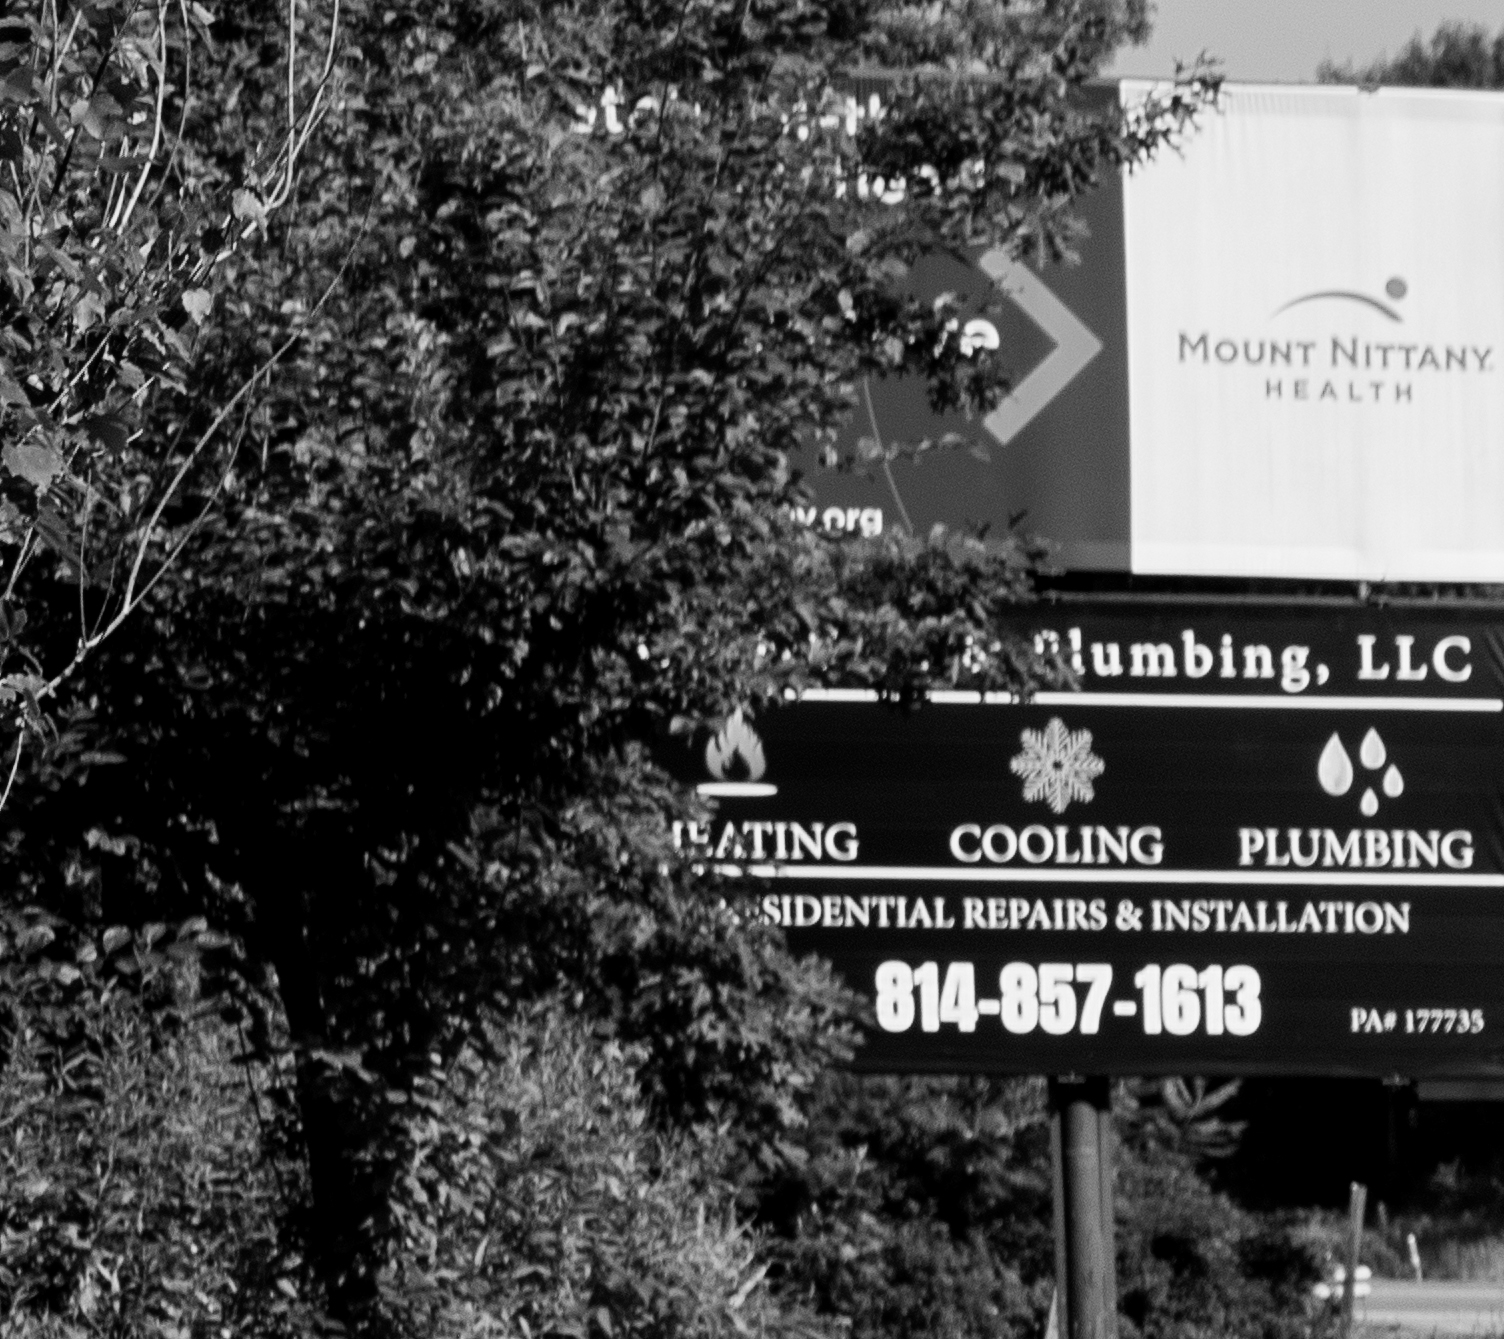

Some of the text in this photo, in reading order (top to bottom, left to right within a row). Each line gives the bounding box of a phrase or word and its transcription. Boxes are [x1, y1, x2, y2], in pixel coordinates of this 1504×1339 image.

[1265, 379, 1412, 401] HEALTH
[1357, 634, 1473, 683] LLC
[949, 823, 1165, 865] COOLING
[1238, 827, 1475, 869] PLUMBING
[757, 894, 1411, 934] SIDENTIAL REPAIRS & INSTALLATION
[874, 960, 1262, 1037] 814-857-1613
[1350, 1006, 1485, 1034] PA# 177735
